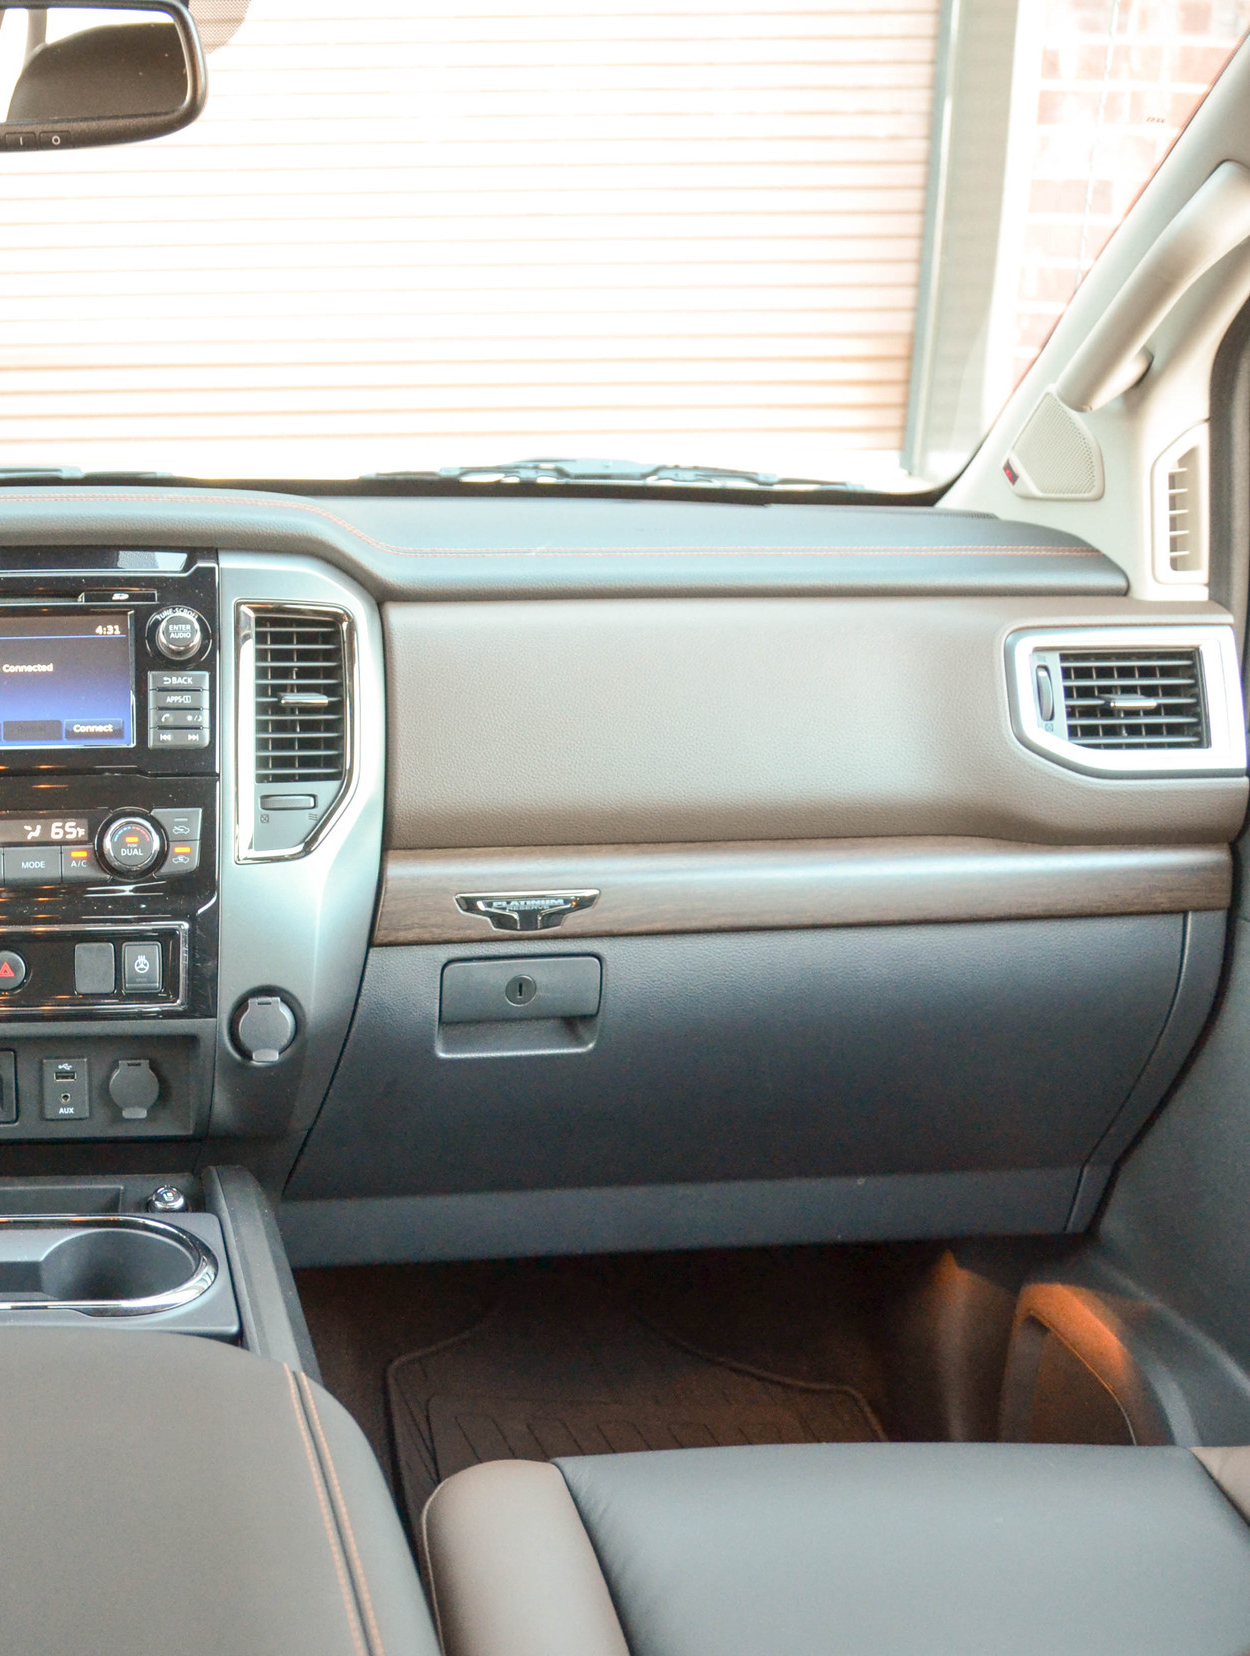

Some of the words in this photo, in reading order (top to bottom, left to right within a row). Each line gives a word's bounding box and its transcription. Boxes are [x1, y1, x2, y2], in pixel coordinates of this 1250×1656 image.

[95, 624, 121, 635] 4:31
[2, 663, 54, 673] Connected
[73, 724, 114, 733] Connect
[121, 848, 144, 856] DUAL
[21, 861, 46, 869] MODE
[70, 860, 87, 868] A/C
